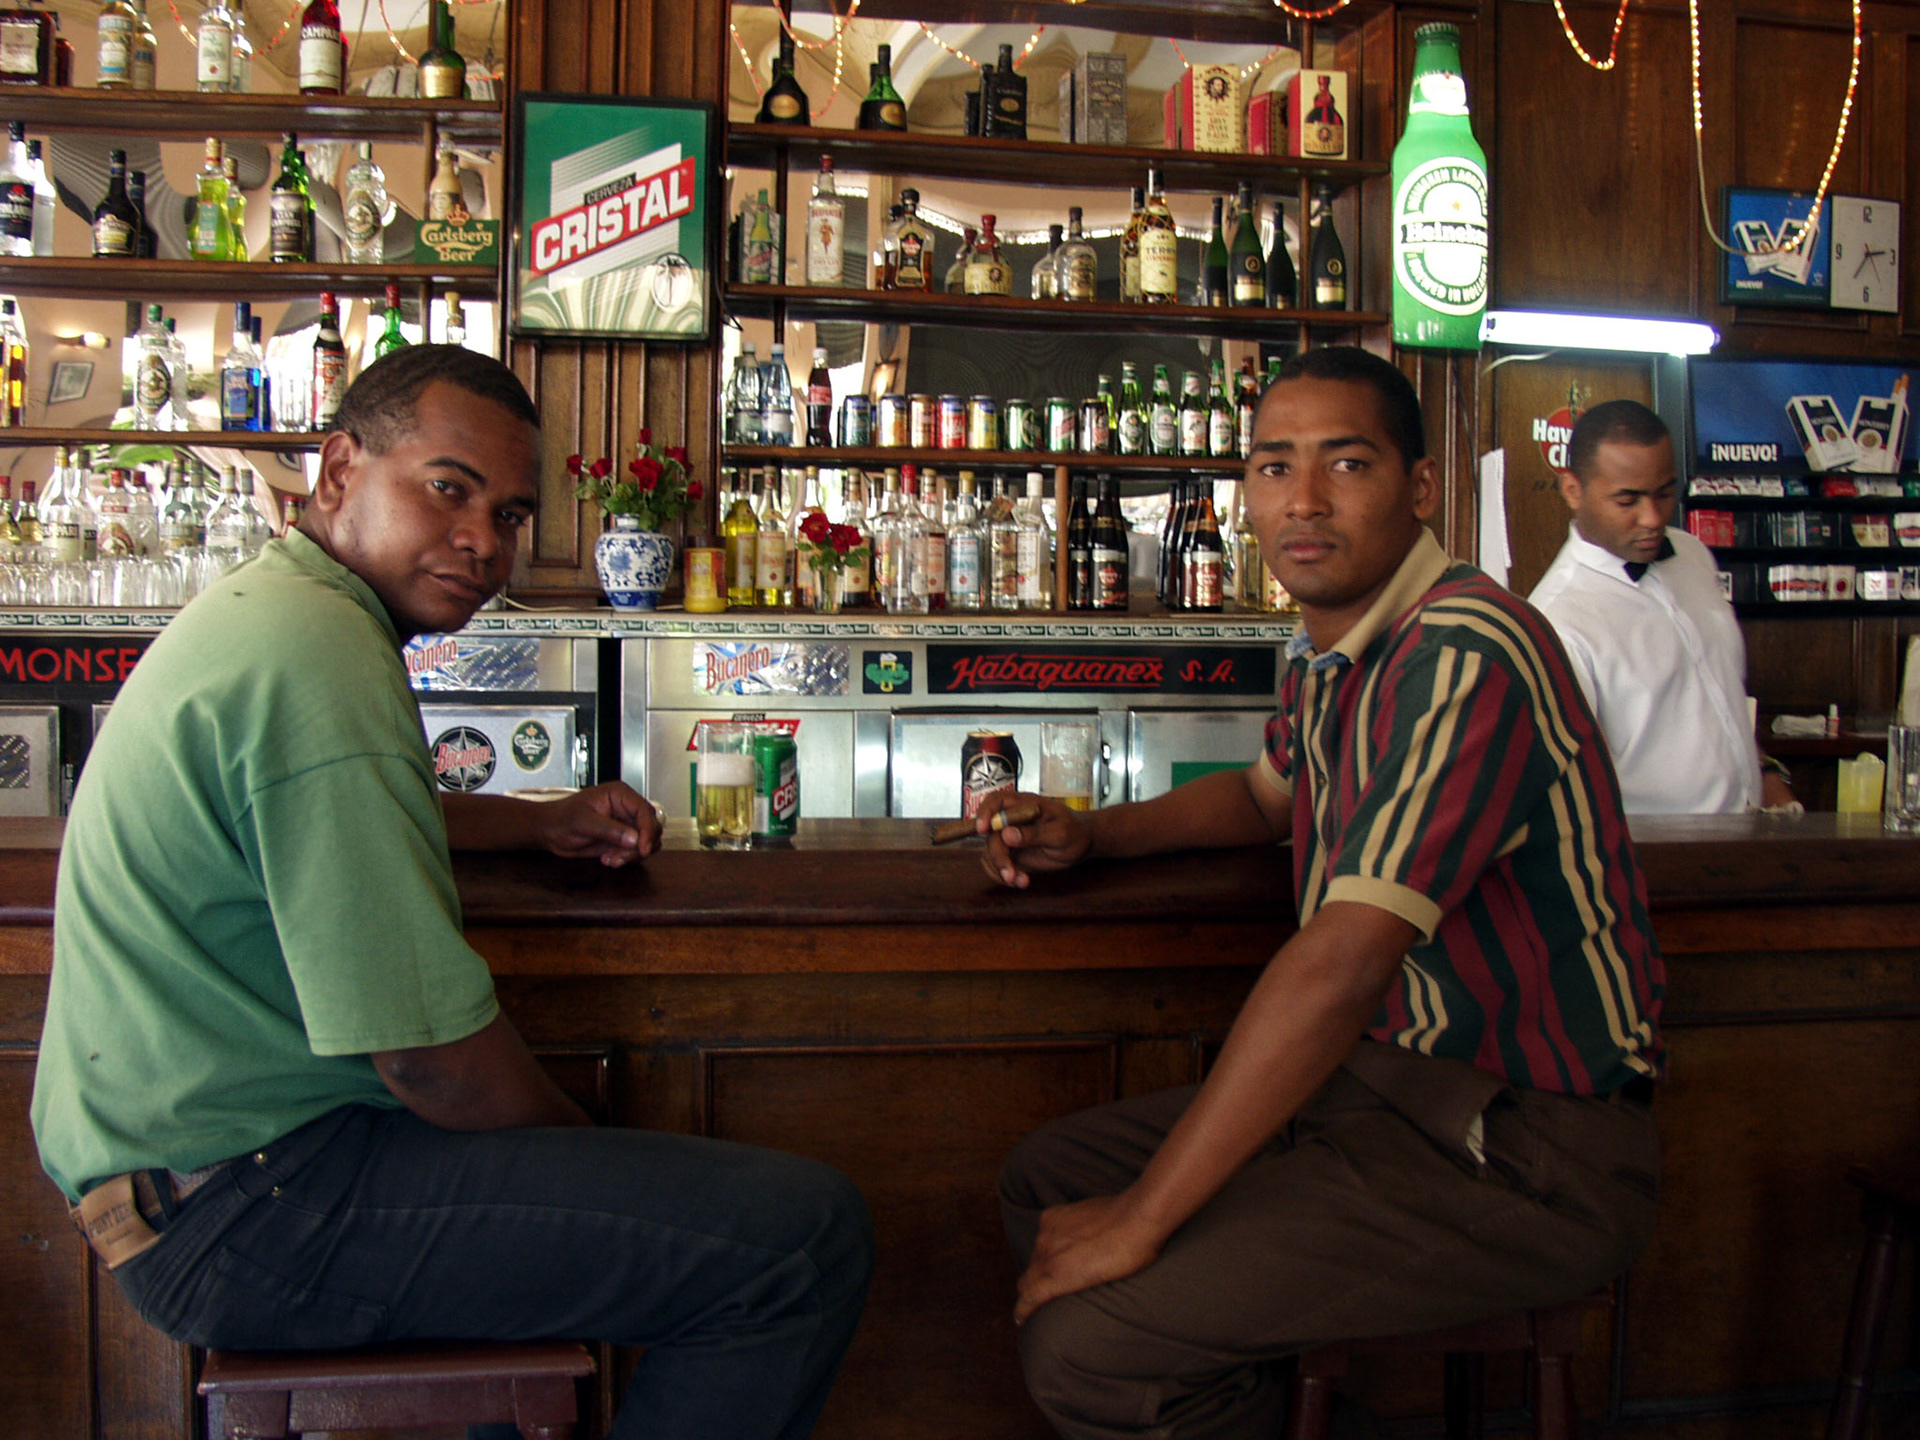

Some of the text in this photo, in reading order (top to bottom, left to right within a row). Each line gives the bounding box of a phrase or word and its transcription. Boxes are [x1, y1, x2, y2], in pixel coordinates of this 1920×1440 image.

[585, 174, 635, 205] CERVEZA
[535, 169, 690, 271] CRISTAL
[420, 222, 493, 248] Carlsberg
[1405, 222, 1488, 247] Heineke
[439, 247, 476, 262] Beer
[1836, 244, 1843, 261] 9
[1889, 248, 1896, 266] 3
[1863, 287, 1870, 303] 6
[1533, 418, 1573, 444] Hav
[1548, 444, 1571, 468] Cl
[1711, 442, 1778, 462] ¡NUEVO!
[0, 648, 138, 681] MONSE
[403, 639, 458, 675] ucanero
[706, 647, 770, 691] Bucanero
[946, 653, 1236, 690] Habaguanex S. A.
[513, 734, 549, 748] Carlsberg
[435, 743, 490, 774] Bucanero
